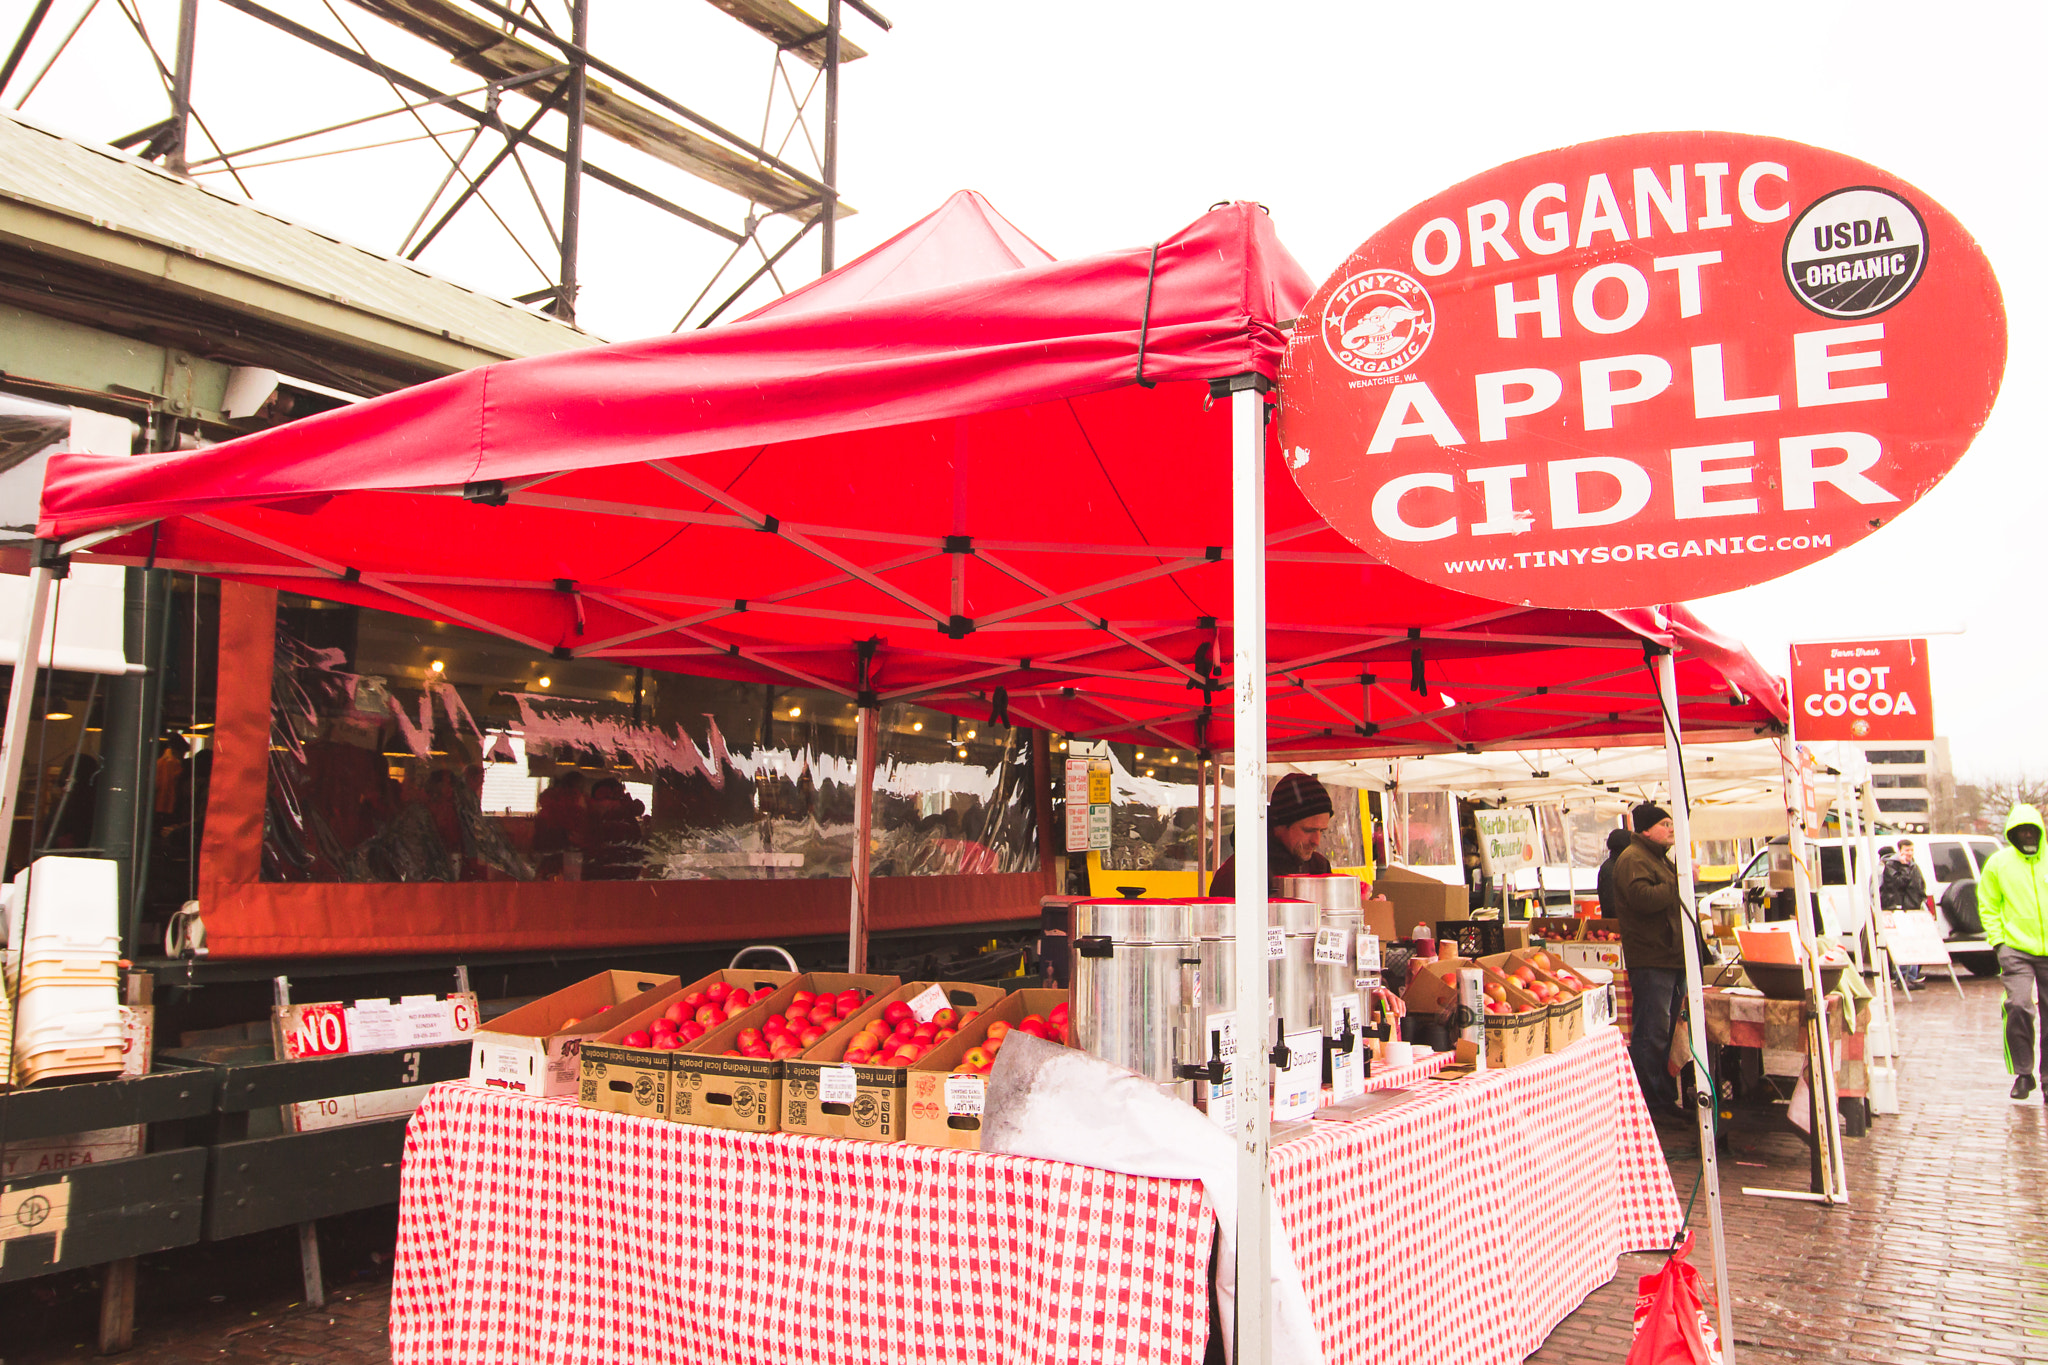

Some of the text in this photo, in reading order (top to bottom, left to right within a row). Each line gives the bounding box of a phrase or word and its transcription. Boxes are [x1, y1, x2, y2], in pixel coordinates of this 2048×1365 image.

[1412, 161, 1790, 277] ORGANIC
[1814, 216, 1894, 252] USDA
[1806, 253, 1906, 287] ORGANIC
[1494, 250, 1724, 339] HOT
[1339, 341, 1420, 372] ORGANIC
[1348, 373, 1418, 389] WENATCHEE, WA
[1365, 323, 1889, 455] APPLE
[1371, 430, 1902, 542] CIDER
[1824, 666, 1890, 691] HOT
[1804, 692, 1917, 717] COCOA
[1317, 949, 1345, 960] Rum Butter
[296, 1012, 342, 1053] NO
[585, 1050, 609, 1060] people
[609, 1053, 626, 1062] local
[626, 1054, 652, 1065] feeding
[679, 1059, 703, 1068] people
[1293, 1050, 1317, 1067] Square
[402, 1051, 421, 1083] 3
[704, 1062, 721, 1071] local
[723, 1061, 751, 1073] feeding
[793, 1068, 820, 1077] people
[876, 1074, 896, 1084] farm
[318, 1099, 338, 1116] TO
[953, 1102, 968, 1111] LADY
